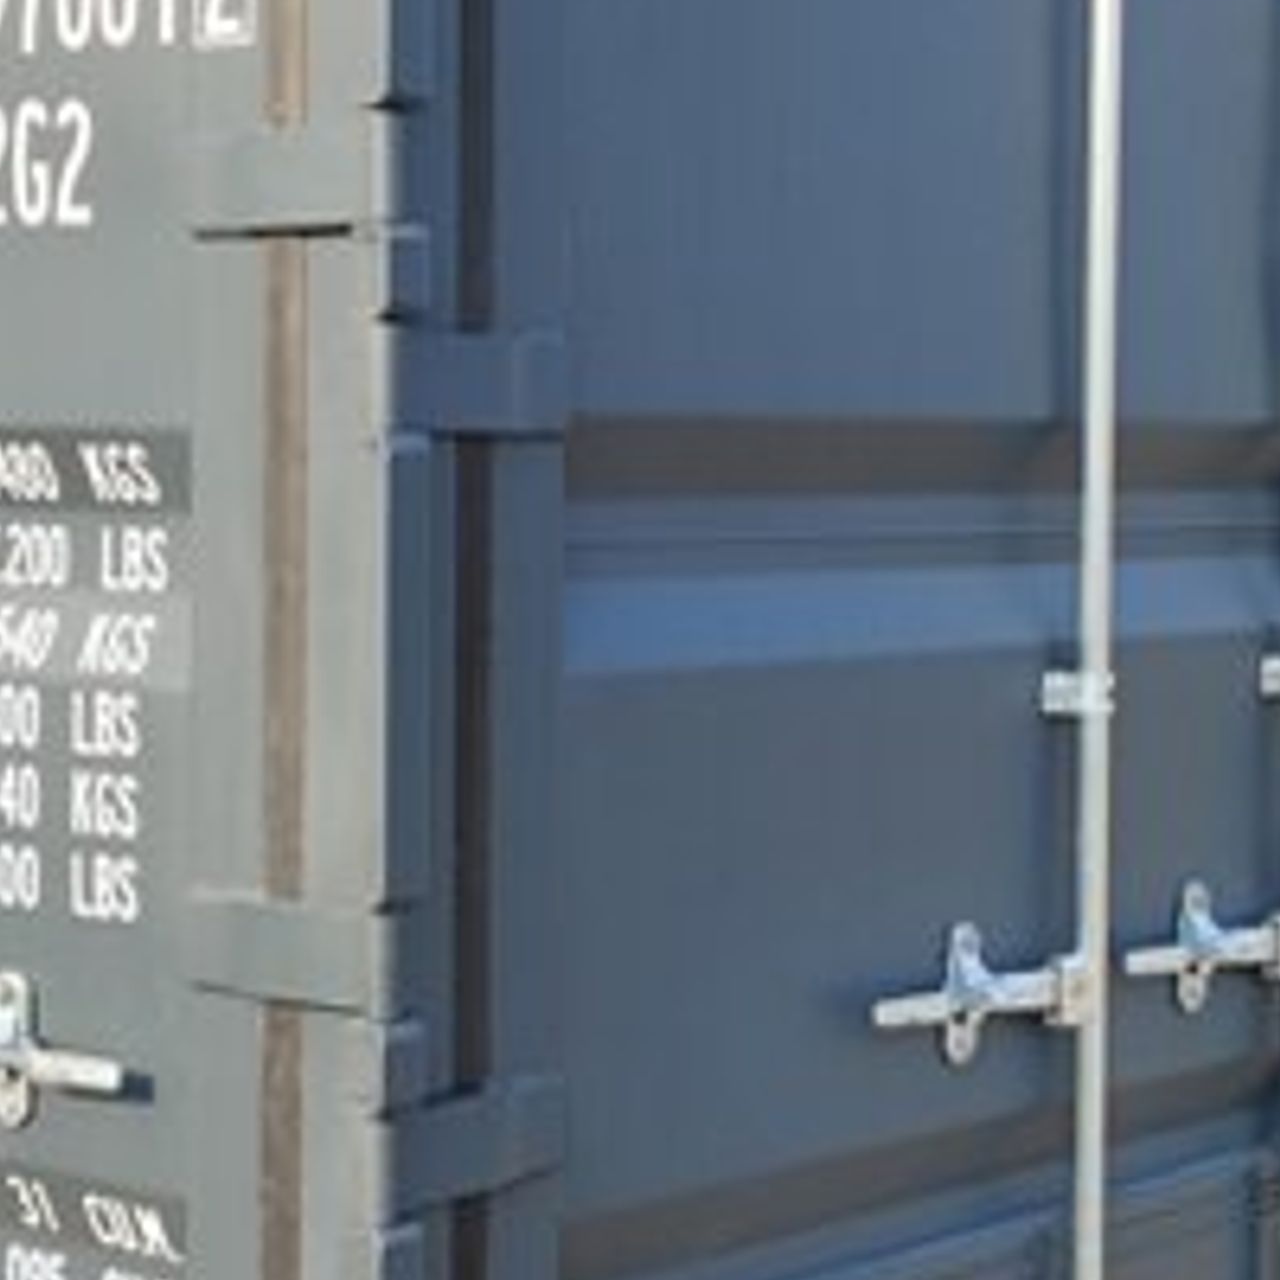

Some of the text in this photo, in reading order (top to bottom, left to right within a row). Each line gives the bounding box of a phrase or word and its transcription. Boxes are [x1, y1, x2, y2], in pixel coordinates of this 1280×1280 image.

[78, 441, 161, 504] KGS
[102, 525, 169, 592] LBS
[78, 613, 156, 675] KGS
[70, 689, 141, 758] LBS
[70, 770, 140, 840] KGS
[70, 851, 140, 923] LBS
[6, 1175, 60, 1232] 31
